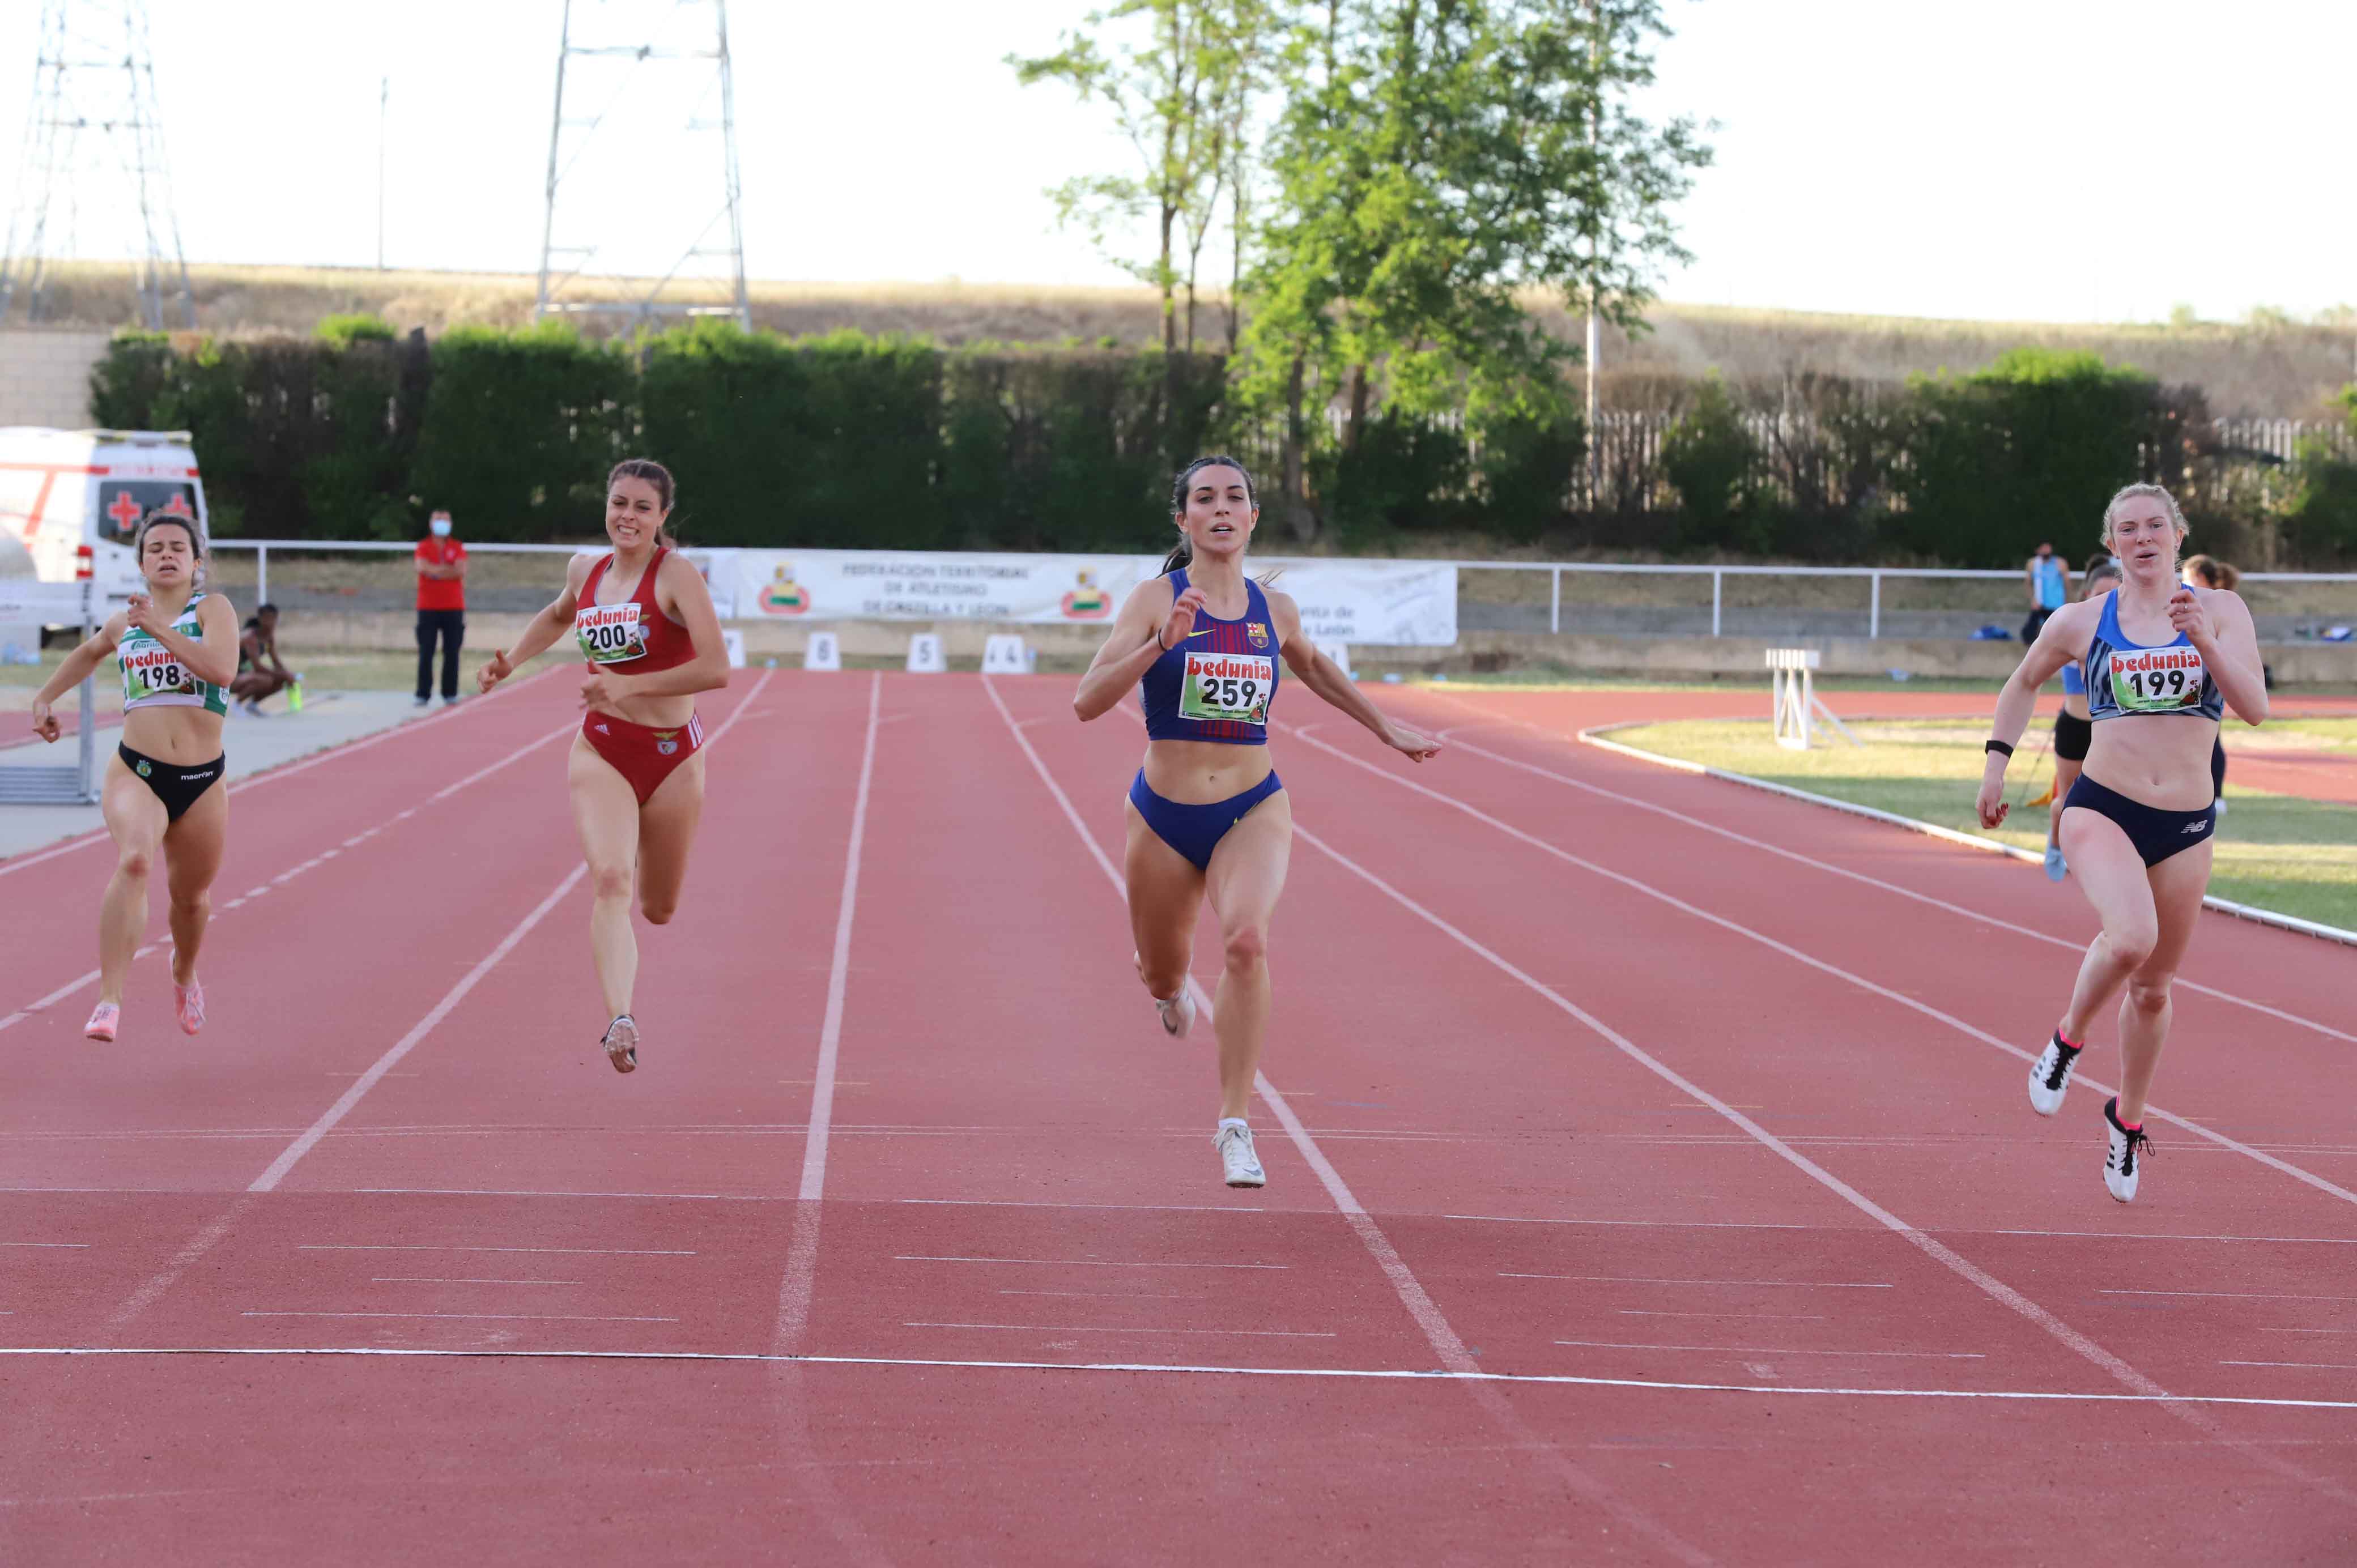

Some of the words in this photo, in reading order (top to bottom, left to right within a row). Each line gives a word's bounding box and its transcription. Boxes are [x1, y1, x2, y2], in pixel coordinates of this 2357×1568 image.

[576, 607, 637, 629] bedunia
[136, 641, 162, 650] Agrilo
[586, 625, 626, 650] 200
[125, 651, 175, 669] bedun
[920, 641, 931, 664] 5
[2111, 651, 2201, 674] bedunia
[139, 664, 180, 688] 198
[1187, 657, 1271, 680] bedunia
[1201, 679, 1256, 707] 259
[2130, 670, 2185, 697] 199
